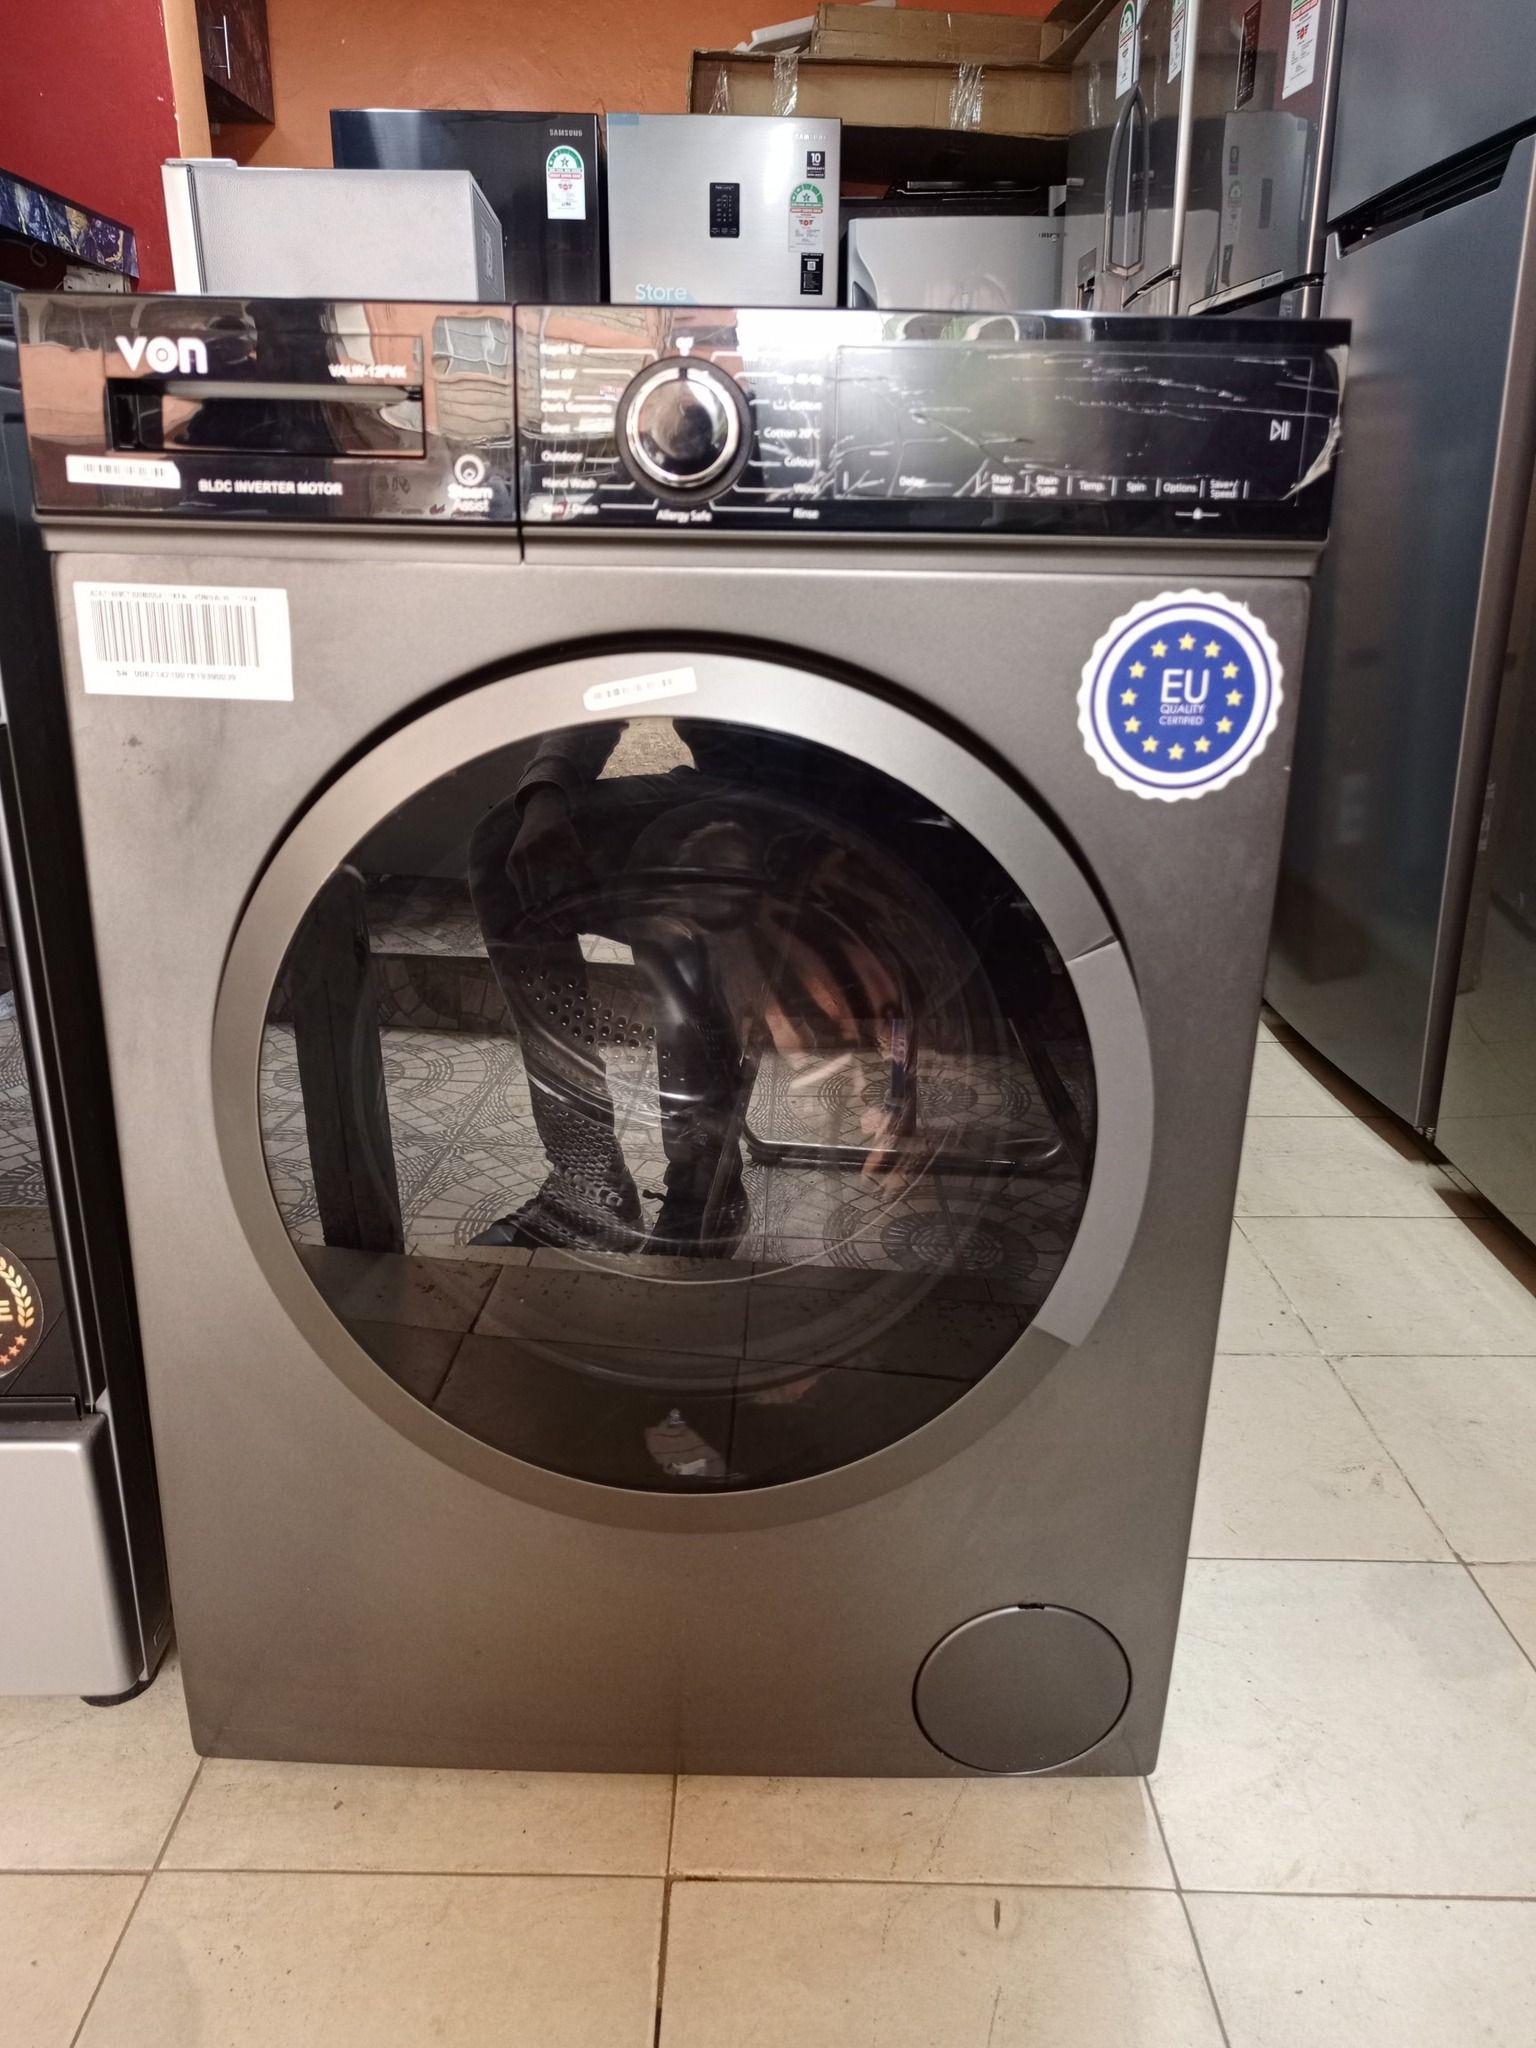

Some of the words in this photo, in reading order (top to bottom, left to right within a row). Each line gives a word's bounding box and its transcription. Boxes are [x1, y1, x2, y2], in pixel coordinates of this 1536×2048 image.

[549, 129, 583, 137] SAMSUNG
[810, 152, 821, 164] 10
[635, 283, 688, 301] Store
[789, 400, 822, 411] Cotton
[763, 427, 796, 440] Cotton
[541, 450, 583, 463] Outdoor
[542, 477, 569, 489] Hand
[570, 478, 597, 490] Wash
[899, 475, 927, 488] Delay
[991, 474, 1015, 484] Stain
[1036, 475, 1060, 485] Stain
[199, 479, 233, 494] BLDC
[235, 480, 295, 495] INVERTER
[297, 480, 343, 496] MOTOR
[1126, 481, 1147, 493] Spin
[1163, 481, 1198, 494] Options
[1210, 489, 1238, 500] Speed
[656, 509, 690, 523] Allergy
[690, 509, 713, 523] Safe
[793, 508, 820, 519] Rinse
[1161, 668, 1209, 704] EU
[1160, 704, 1205, 714] QUALITY
[1159, 716, 1204, 725] CERTIFIED
